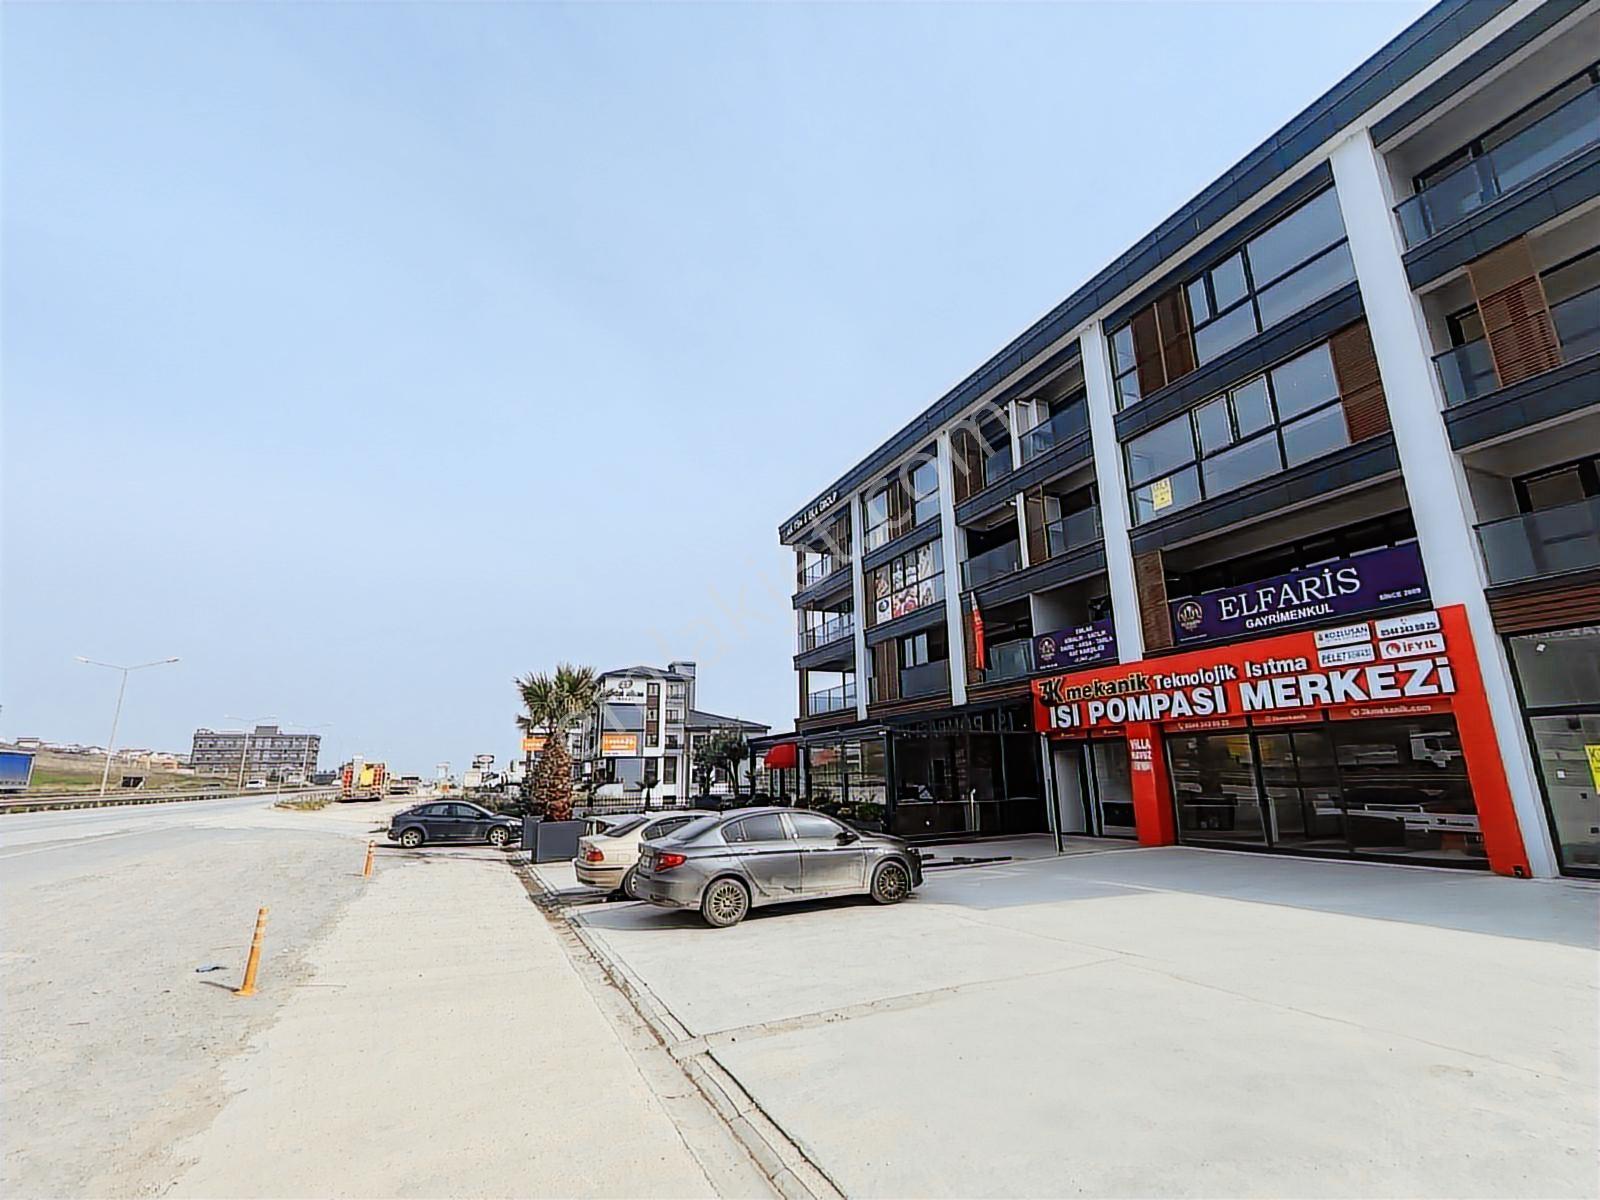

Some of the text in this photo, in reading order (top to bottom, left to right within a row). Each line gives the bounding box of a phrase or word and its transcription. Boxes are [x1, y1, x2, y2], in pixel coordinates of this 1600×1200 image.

[1218, 568, 1361, 621] ELFARİS
[1245, 603, 1334, 629] GAYRİMENKUL
[1049, 656, 1456, 729] ISI POMPASI MERKEZİ
[1065, 672, 1151, 701] mekanik
[1153, 664, 1237, 690] Teknolojik
